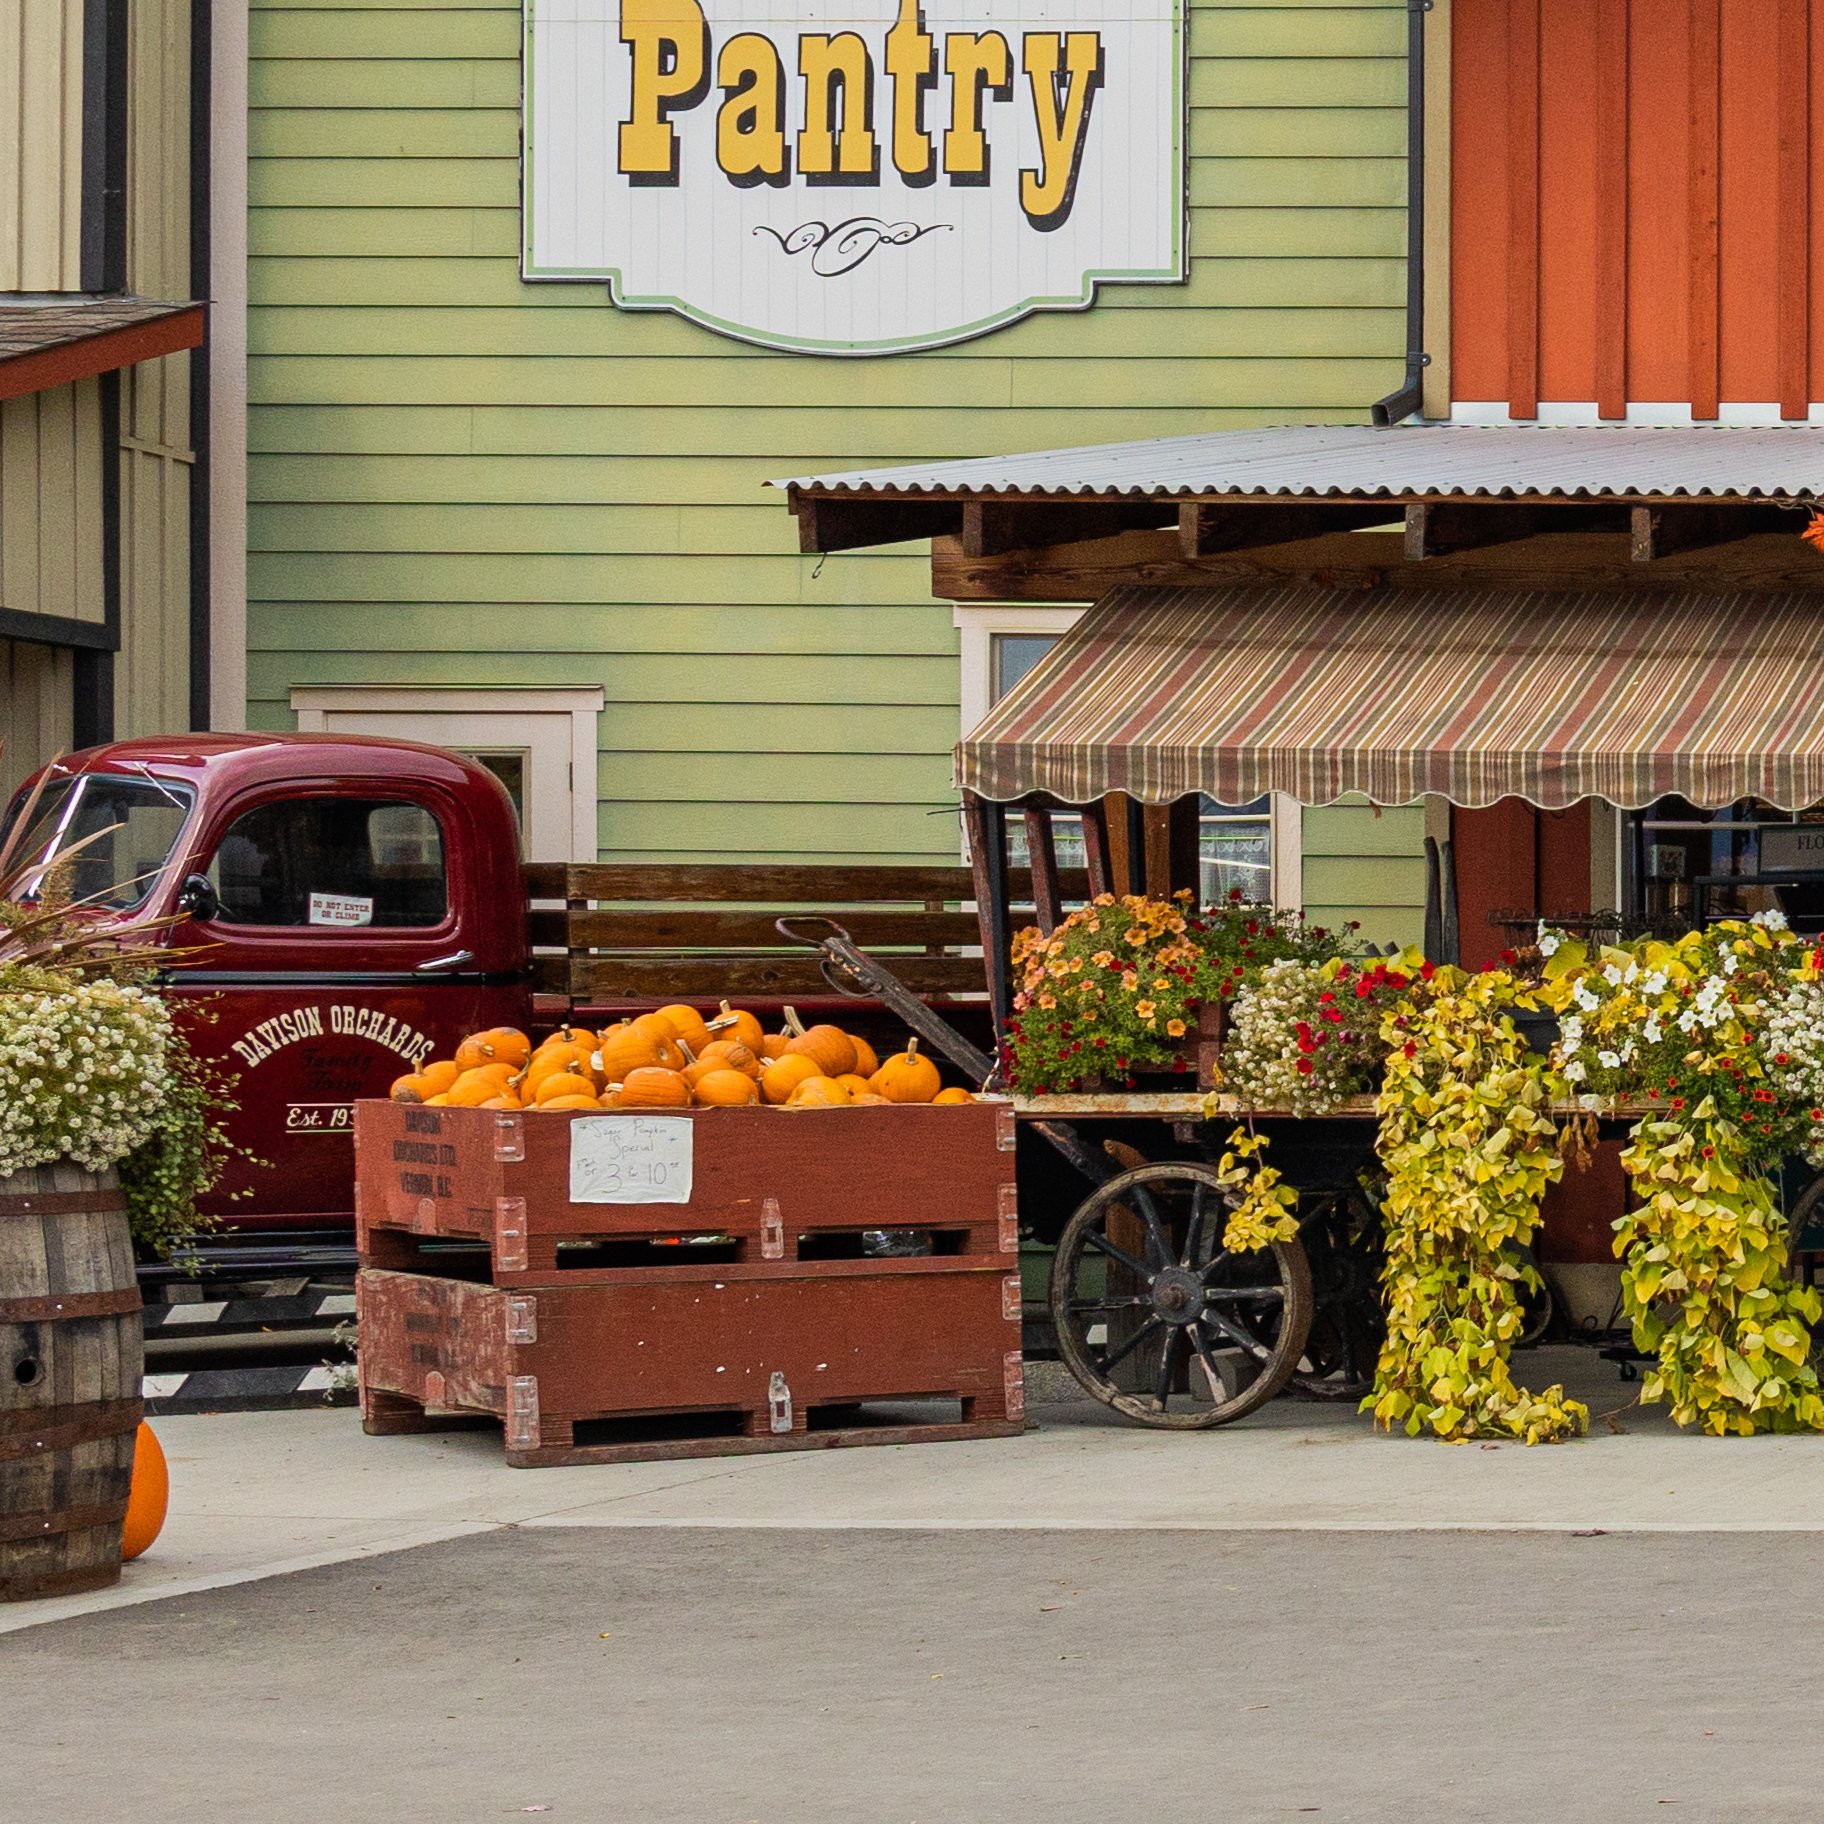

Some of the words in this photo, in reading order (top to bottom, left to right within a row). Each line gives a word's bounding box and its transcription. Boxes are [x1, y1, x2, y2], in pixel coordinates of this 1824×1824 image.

[326, 901, 341, 910] NOT
[344, 903, 370, 913] ENTER
[231, 1006, 325, 1068] DAVISON
[330, 1005, 435, 1064] ORCHARDS
[286, 1107, 323, 1127] Est.
[609, 1135, 654, 1160] Special
[601, 1163, 623, 1194] 3
